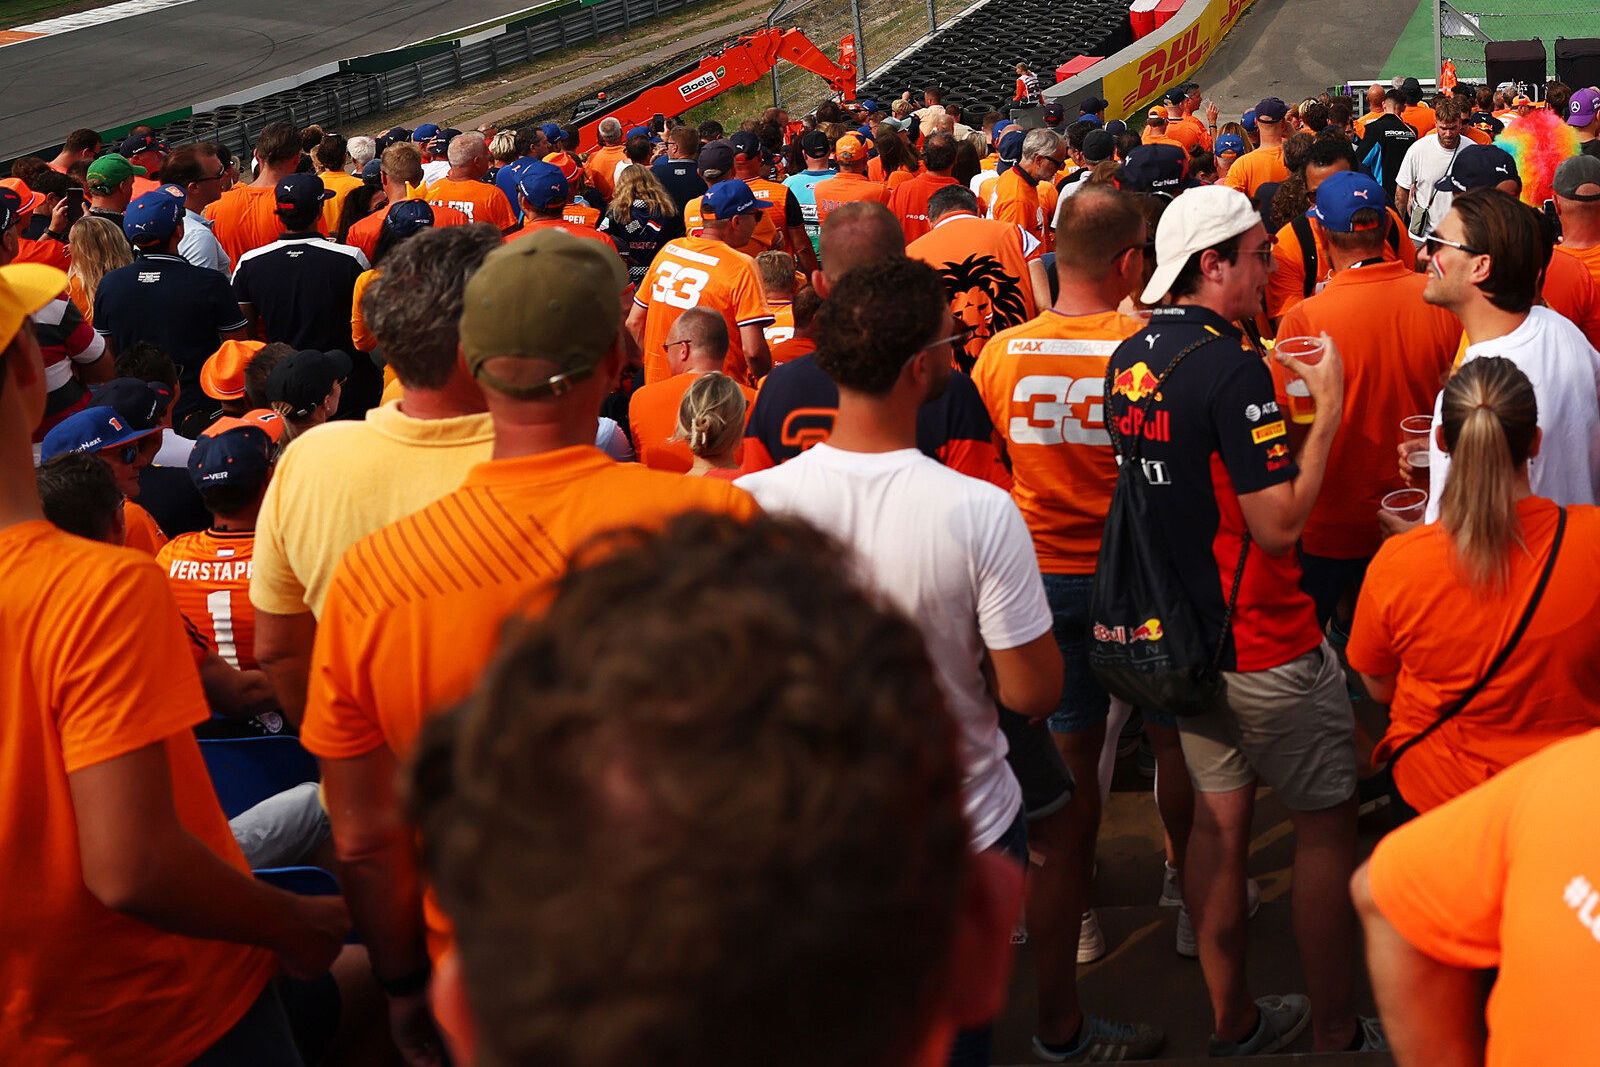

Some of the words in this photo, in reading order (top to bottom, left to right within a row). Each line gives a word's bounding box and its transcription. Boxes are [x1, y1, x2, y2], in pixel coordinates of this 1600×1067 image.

[1137, 22, 1202, 103] DHL
[680, 72, 715, 95] Boels
[1152, 177, 1180, 188] CarNext
[652, 260, 710, 310] 33
[108, 417, 124, 432] 1
[1009, 375, 1114, 446] 33
[208, 470, 229, 481] VER
[206, 590, 242, 671] 1
